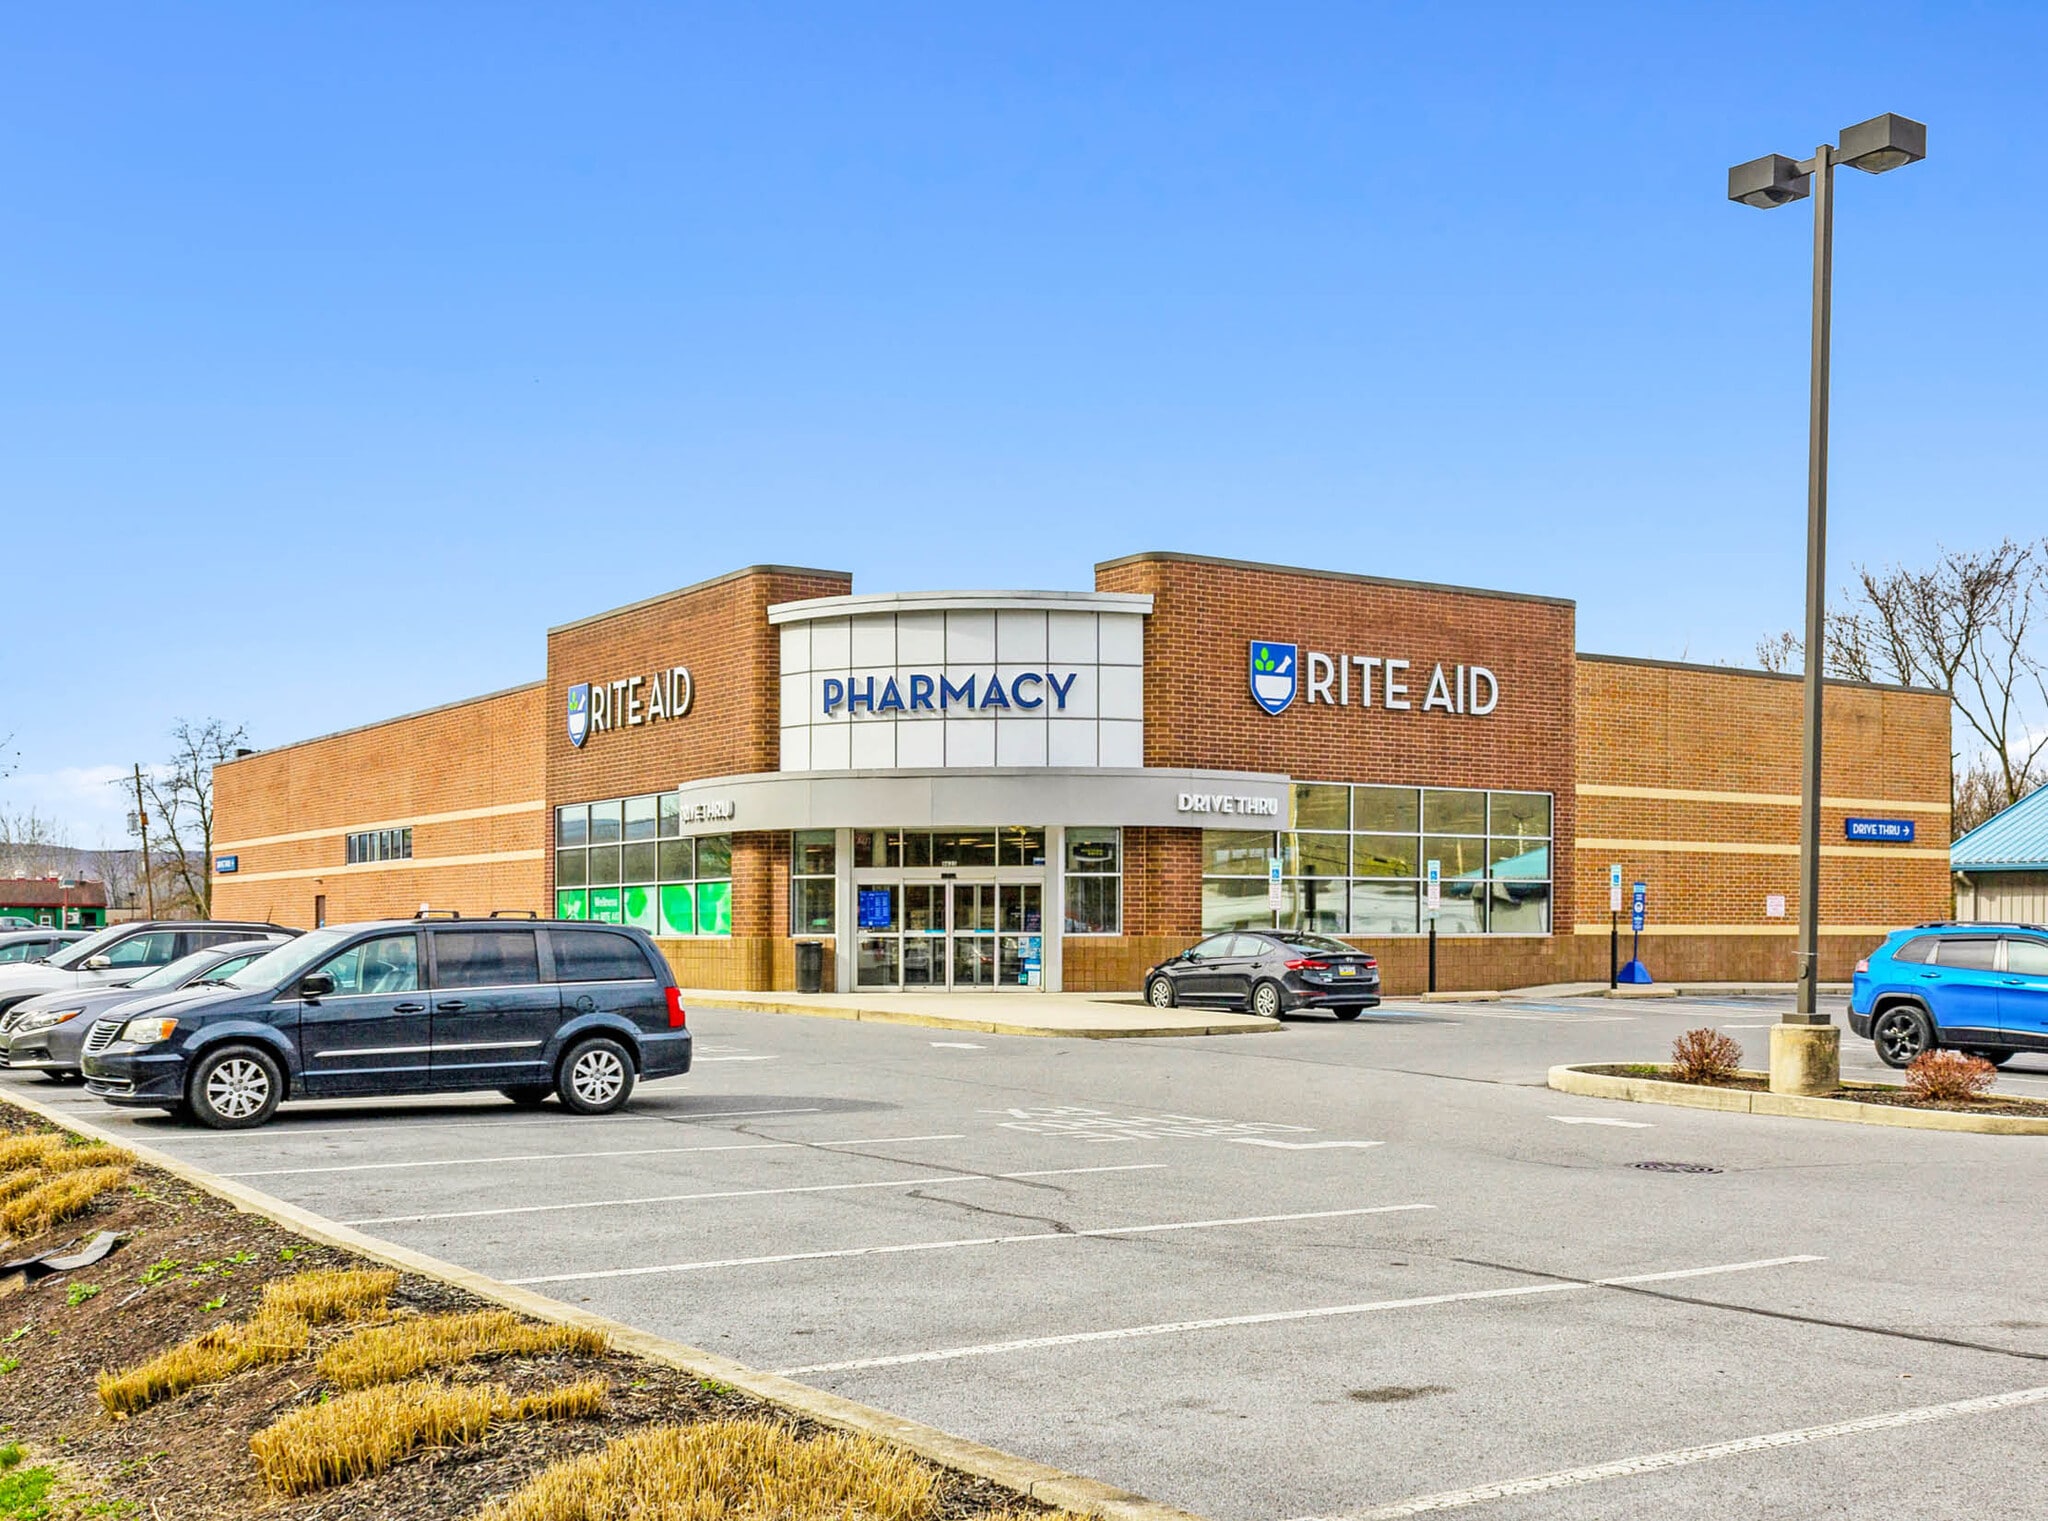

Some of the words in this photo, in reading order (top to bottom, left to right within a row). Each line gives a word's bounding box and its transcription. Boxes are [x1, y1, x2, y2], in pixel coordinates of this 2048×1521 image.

[591, 676, 644, 733] RITE
[647, 666, 693, 721] AID
[823, 672, 1078, 715] PHARMACY
[1306, 651, 1412, 711] RITE
[1422, 662, 1500, 717] AID
[1177, 793, 1234, 813] DRIVE
[1234, 796, 1279, 816] THRU
[1852, 823, 1878, 835] DRIVE
[1878, 824, 1901, 836] THRU
